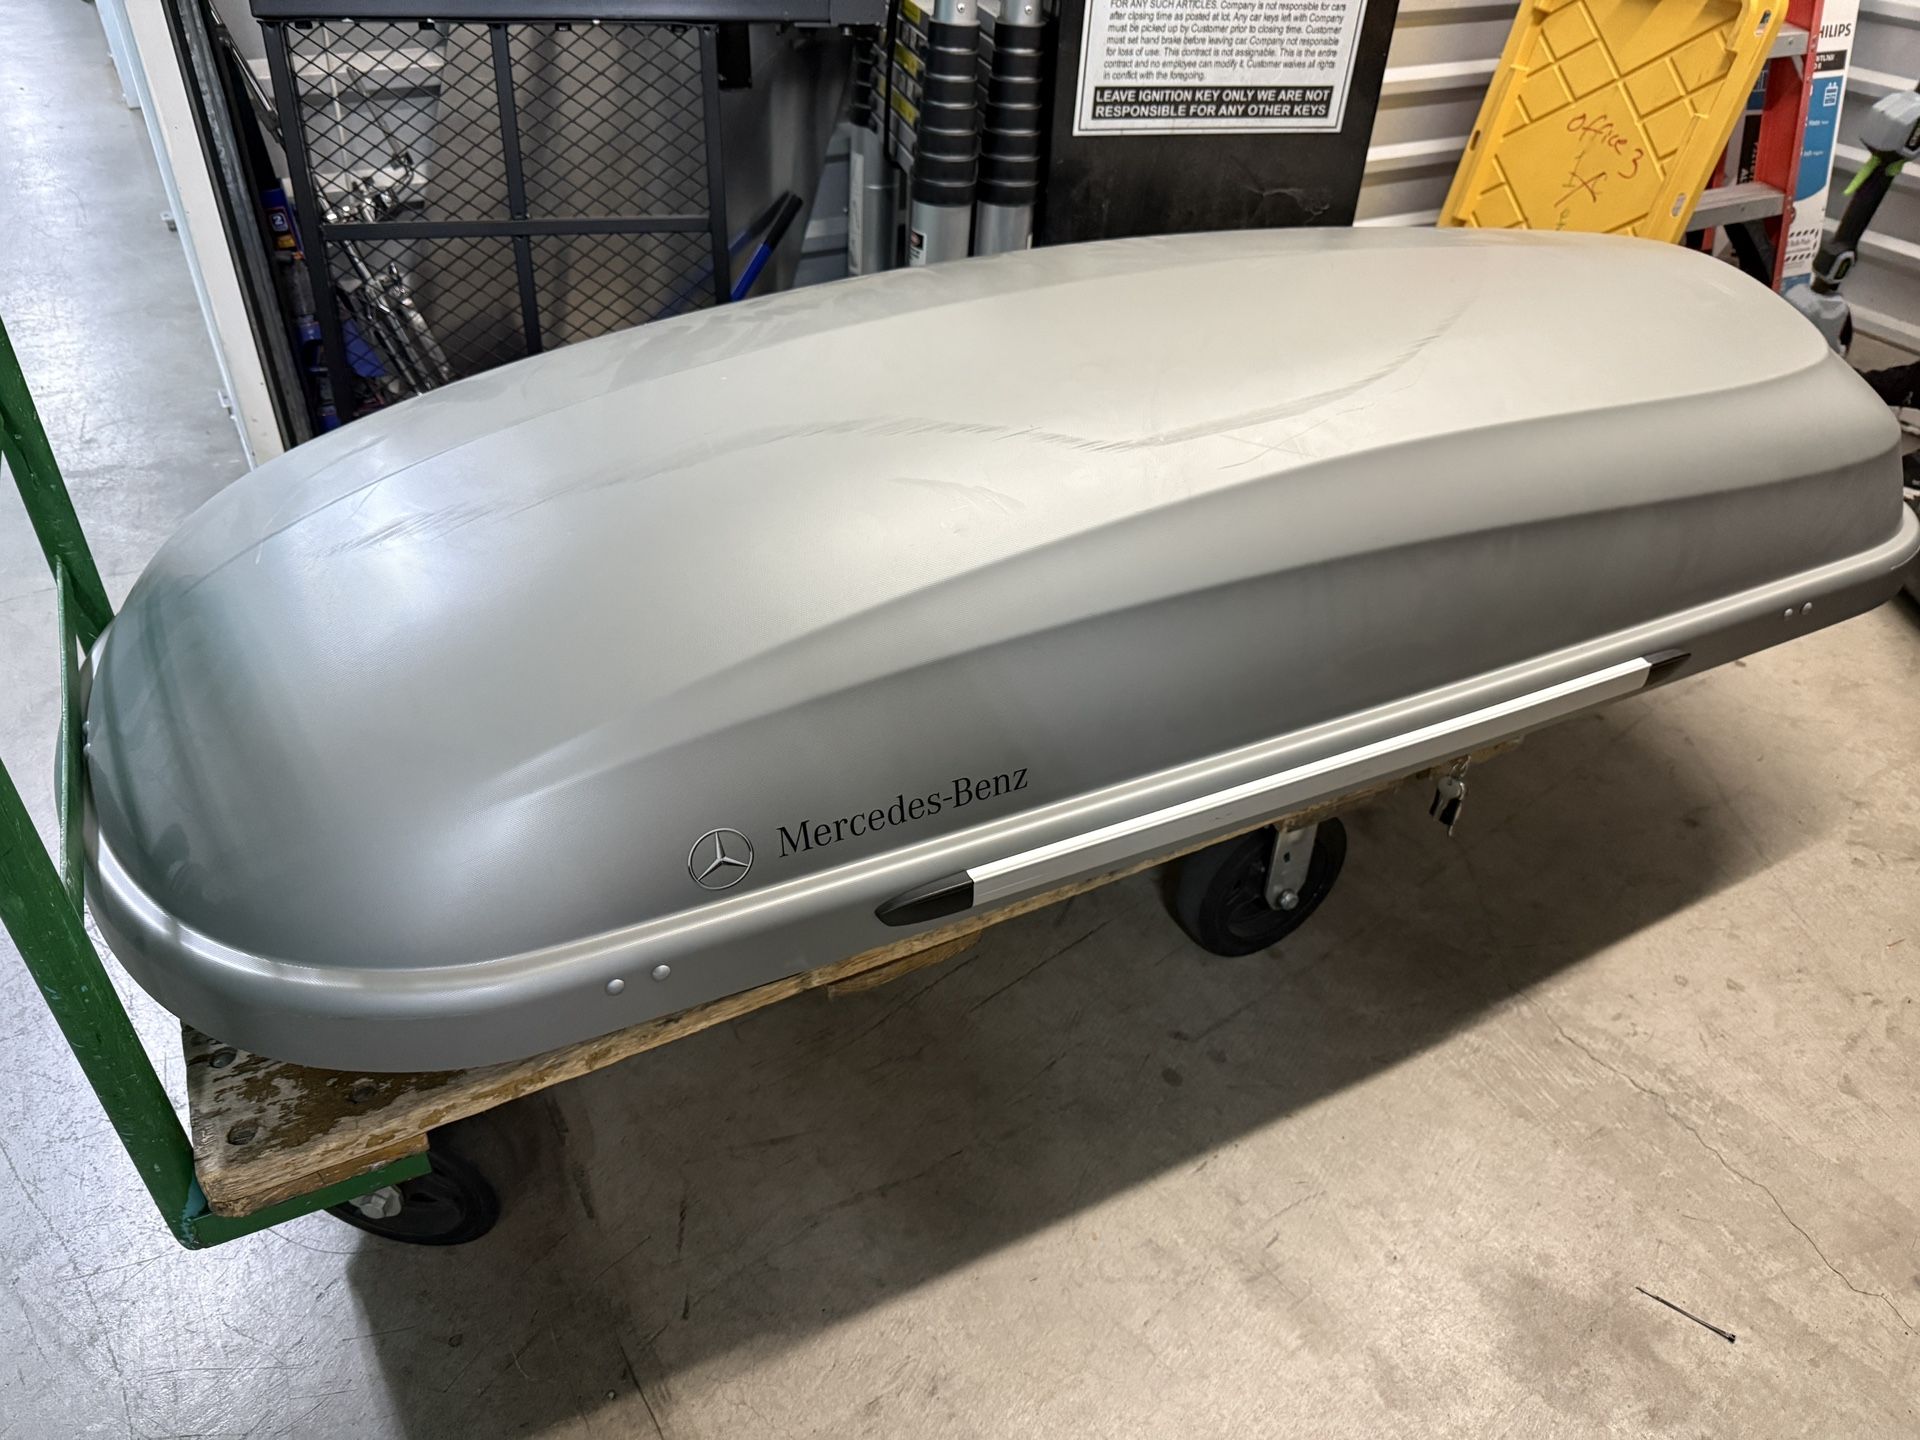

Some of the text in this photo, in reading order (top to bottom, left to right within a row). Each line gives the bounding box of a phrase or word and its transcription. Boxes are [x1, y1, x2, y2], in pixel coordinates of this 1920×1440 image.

[1110, 0, 1128, 8] FOR
[1130, 0, 1148, 8] ANY
[1149, 0, 1175, 9] SUCH
[1220, 1, 1257, 11] Company
[1257, 2, 1264, 10] is
[1265, 2, 1277, 10] not
[1279, 2, 1319, 12] responsible
[1320, 2, 1330, 11] for
[1331, 3, 1346, 11] cars
[1108, 24, 1127, 32] must
[1129, 23, 1139, 32] be
[1141, 23, 1166, 34] picked
[1167, 25, 1178, 34] up
[1180, 23, 1190, 34] by
[1191, 23, 1228, 33] Customer
[1230, 24, 1247, 34] prior
[1249, 25, 1256, 33] to
[1258, 24, 1284, 36] closing
[1305, 25, 1342, 34] Customer
[1819, 23, 1852, 38] HILIPS
[1096, 89, 1330, 102] LEAVE IGNITION KEY ONLY WE ARE NOT
[1095, 104, 1326, 117] RESPONSIBLE FOR ANY OTHER KEYS
[1617, 148, 1643, 179] 3
[272, 215, 283, 225] 2
[776, 767, 1029, 858] Mercedes-Benz
